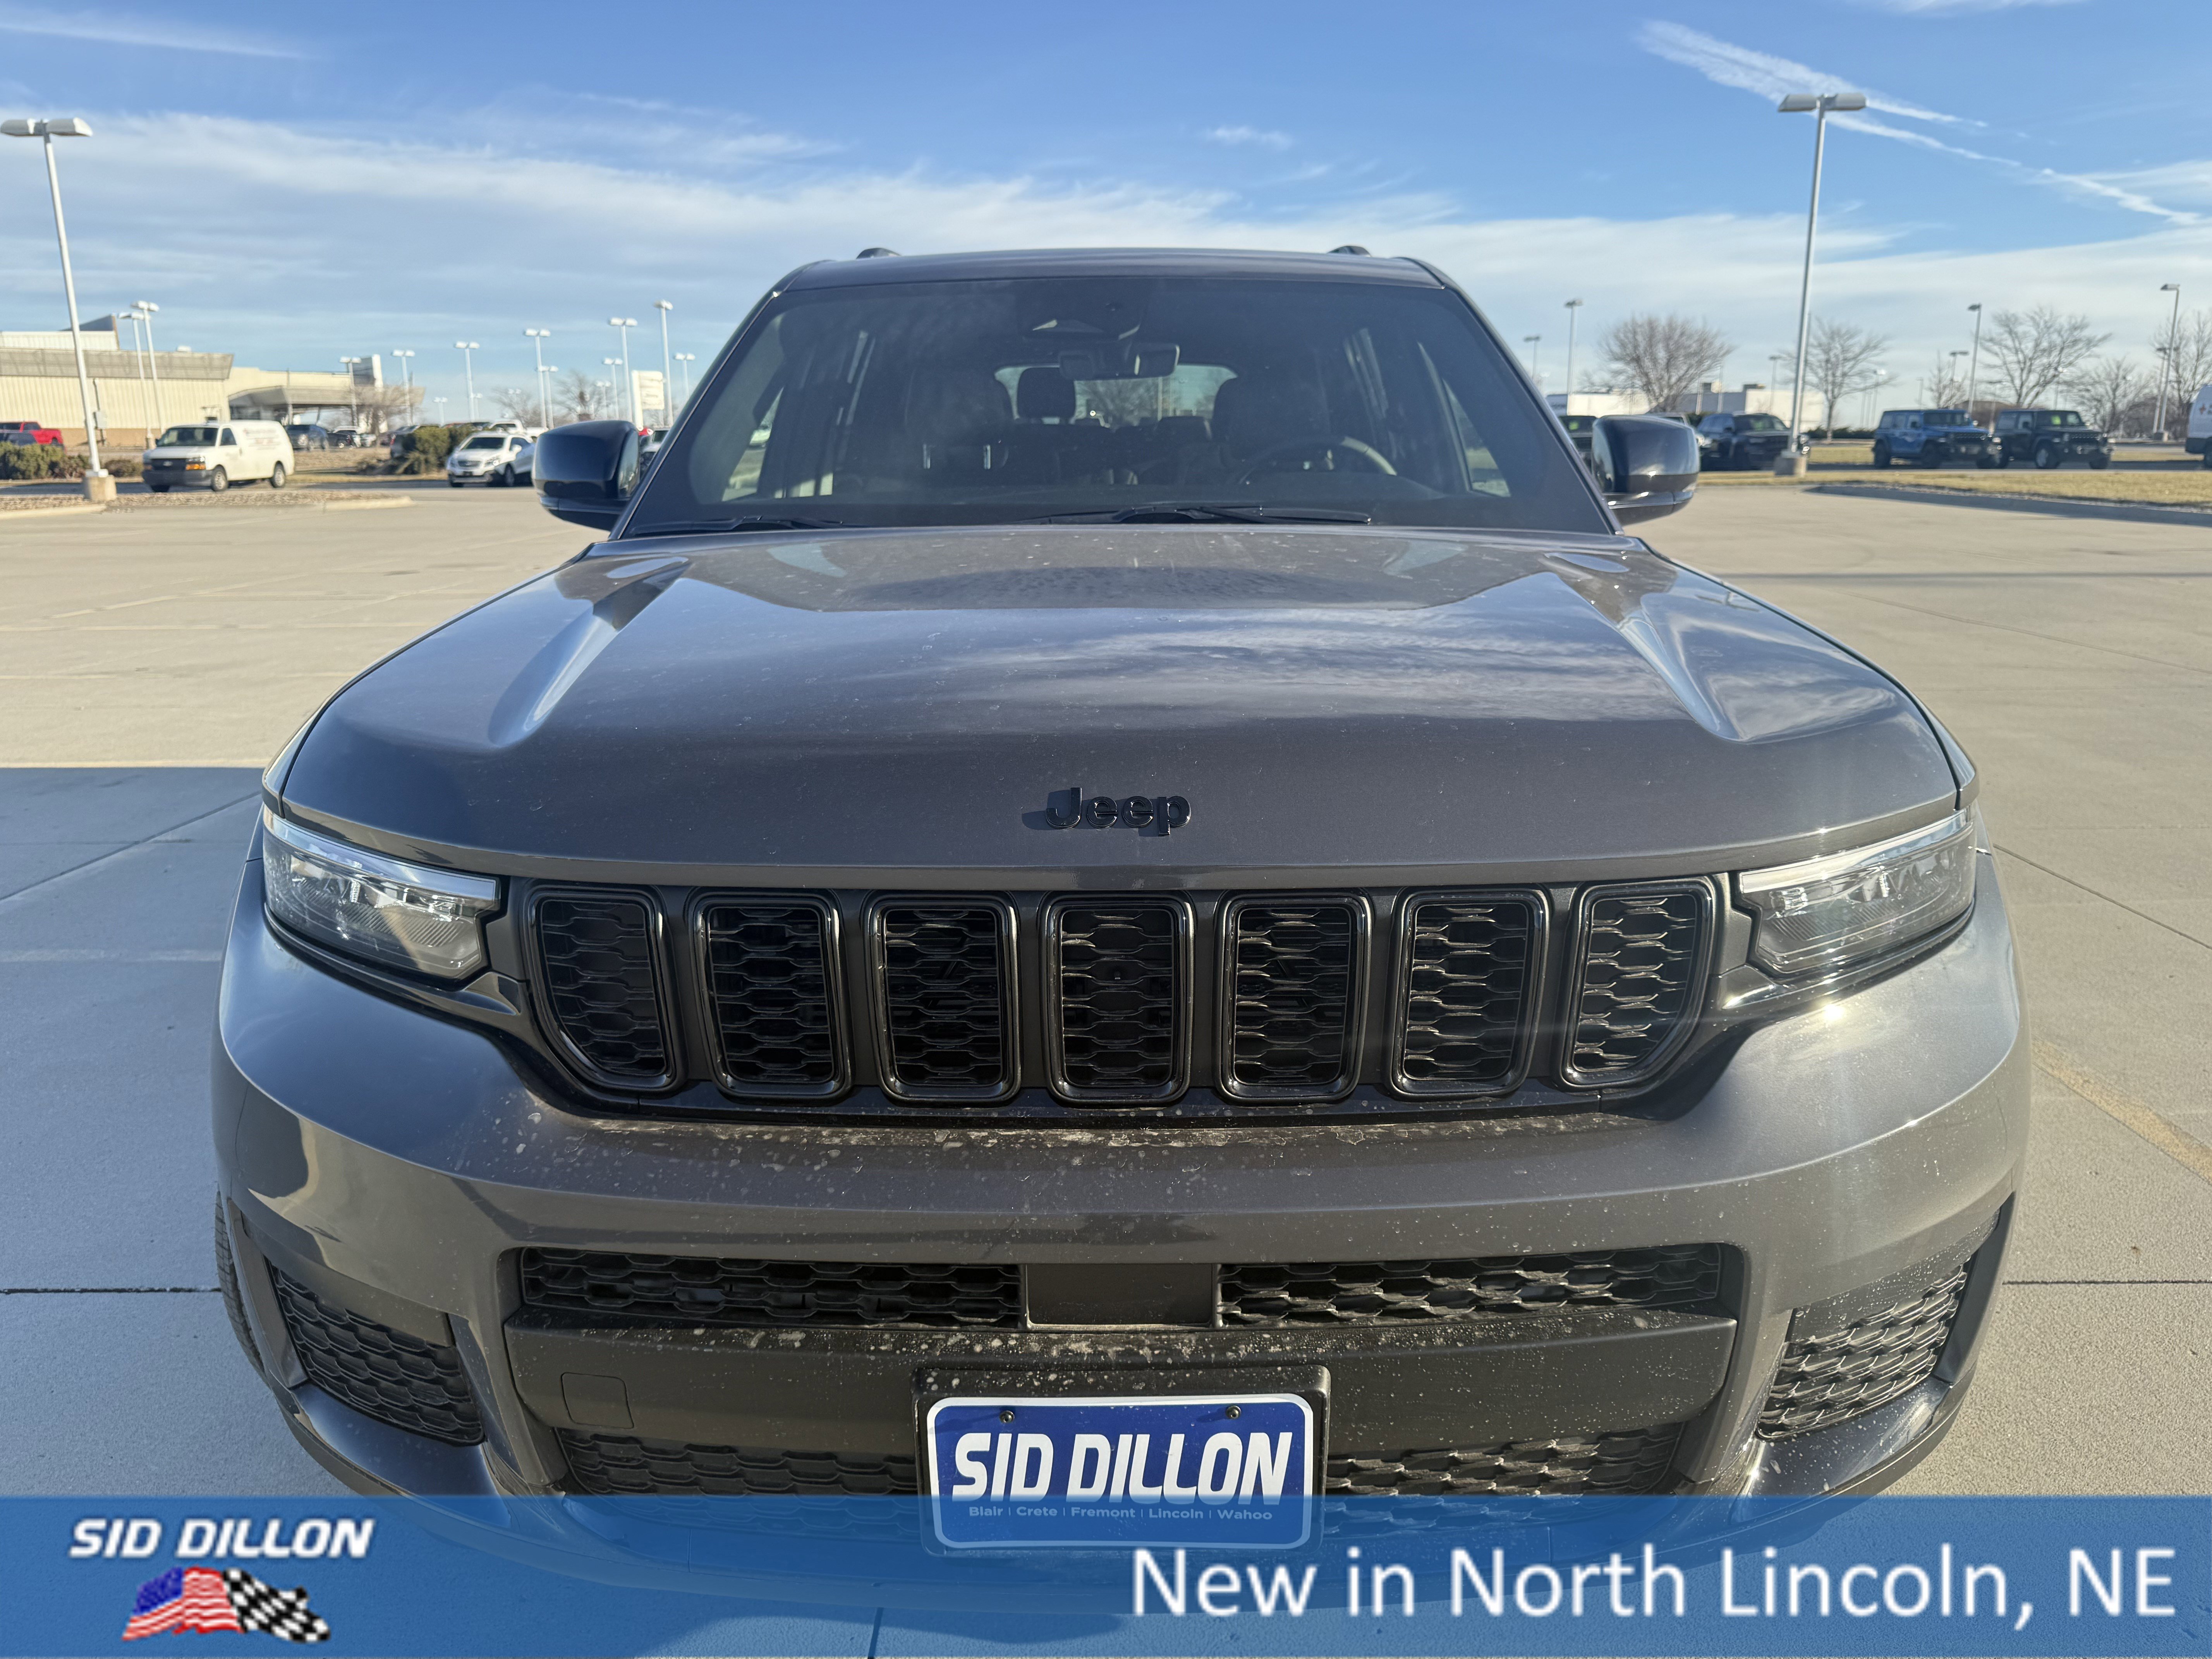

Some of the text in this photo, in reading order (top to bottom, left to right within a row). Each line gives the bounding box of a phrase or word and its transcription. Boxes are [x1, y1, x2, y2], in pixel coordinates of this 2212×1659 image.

[1046, 787, 1192, 836] Jeep
[951, 1432, 1293, 1505] SID DILLON
[969, 1506, 1273, 1520] Blair Crete Fremont Lincoln Wahoo
